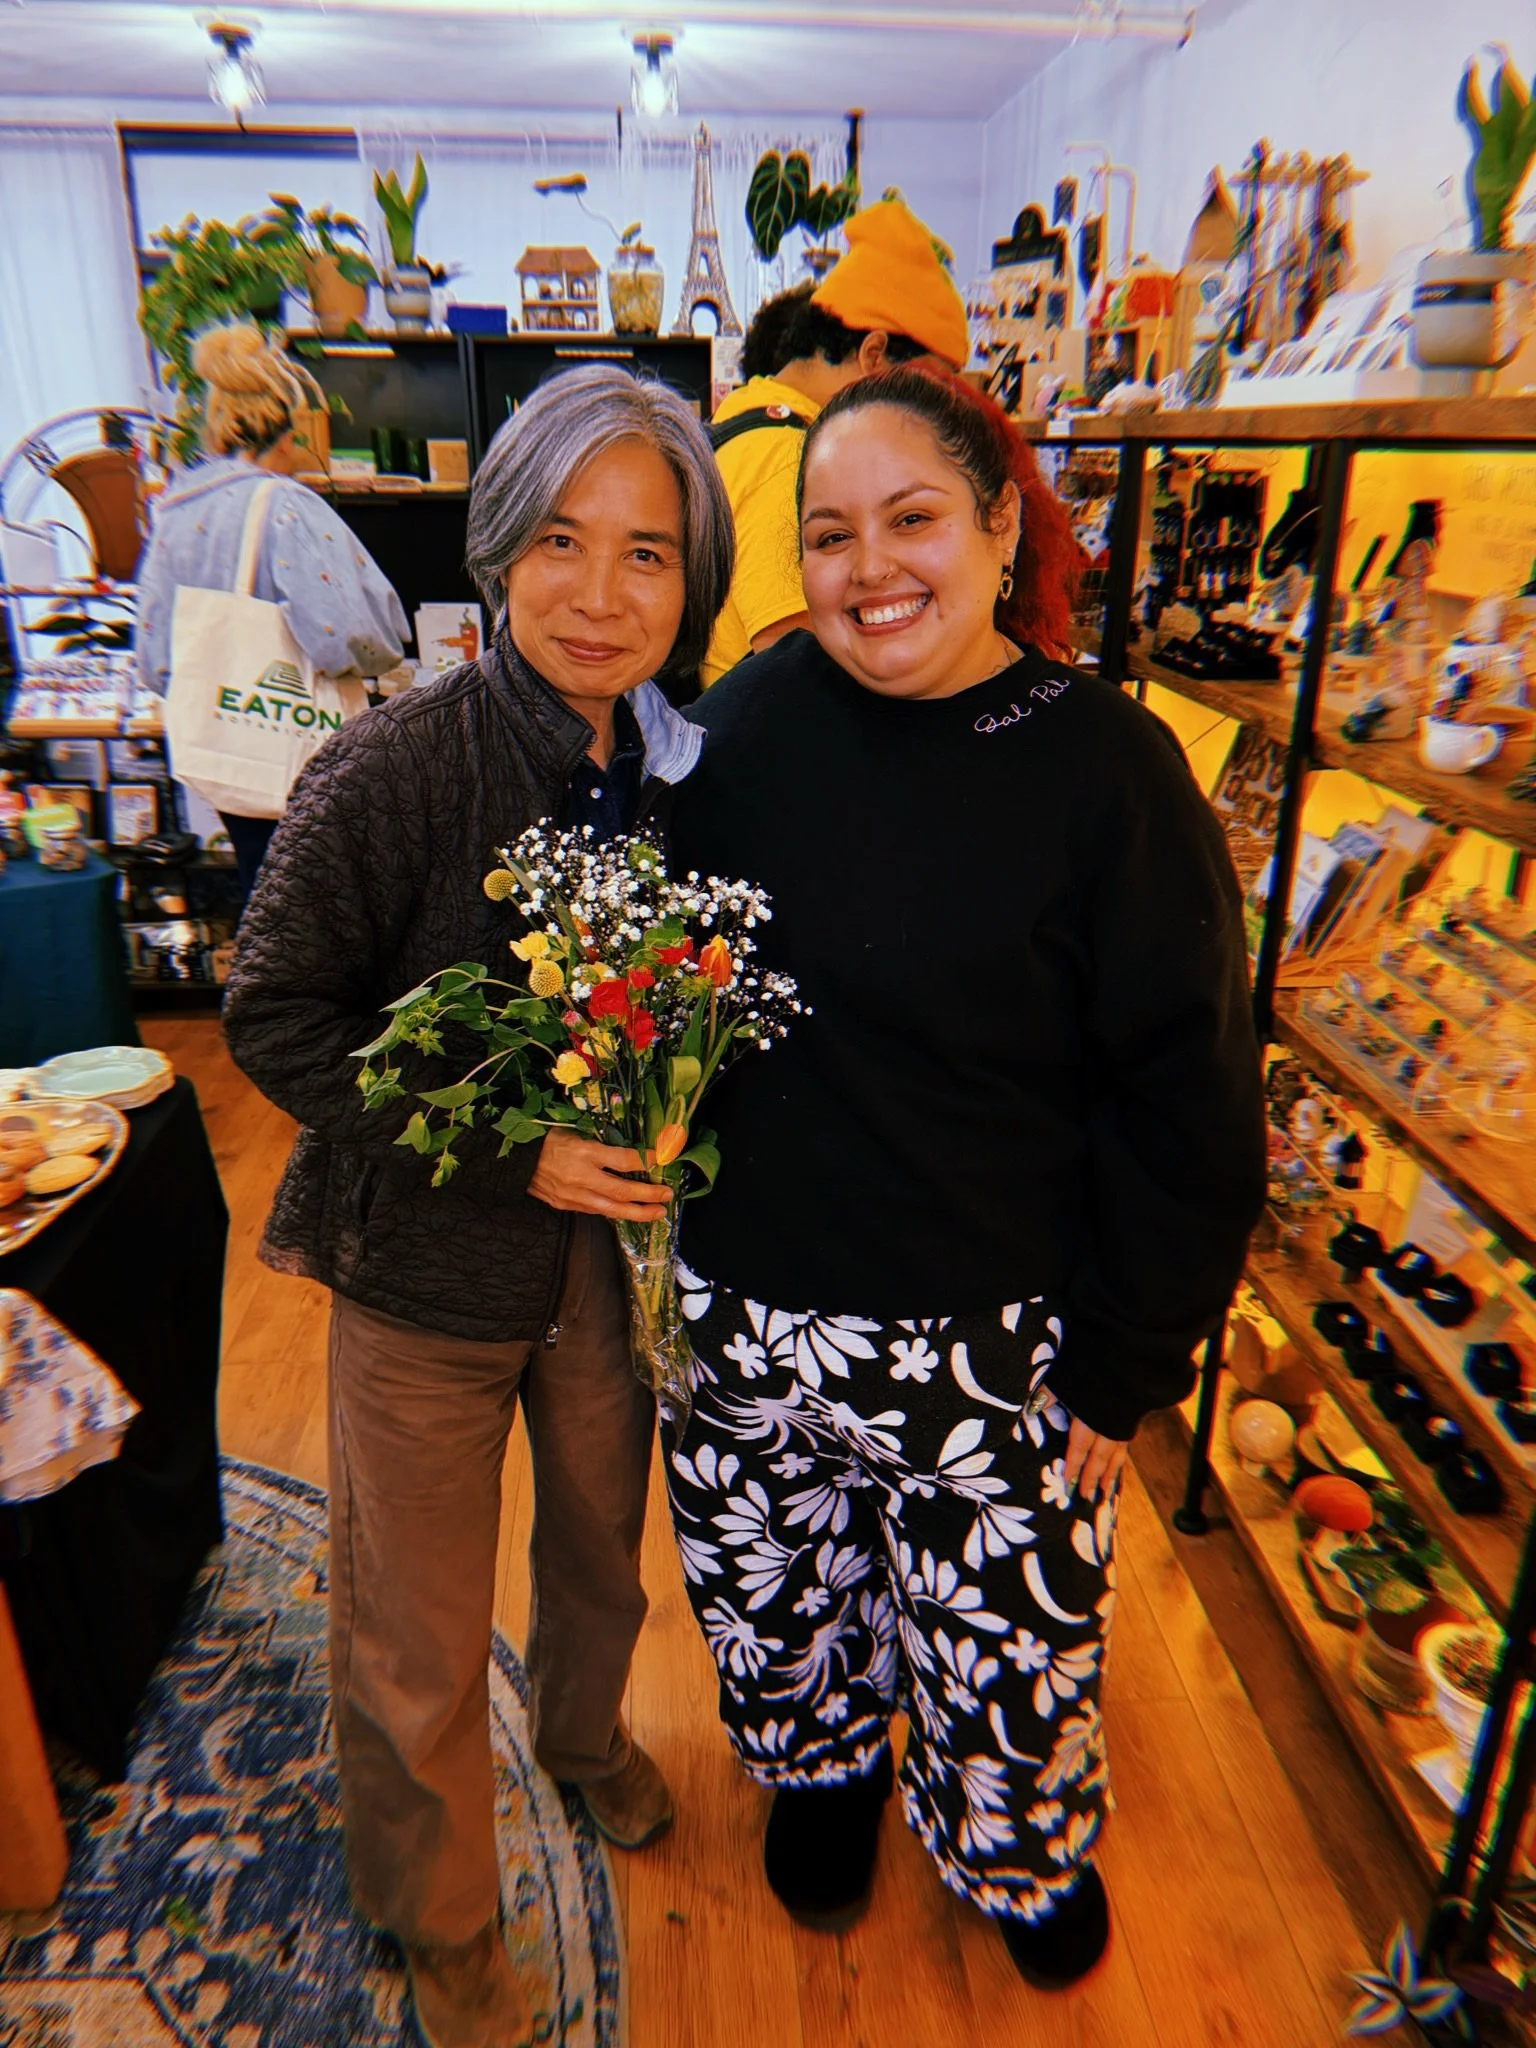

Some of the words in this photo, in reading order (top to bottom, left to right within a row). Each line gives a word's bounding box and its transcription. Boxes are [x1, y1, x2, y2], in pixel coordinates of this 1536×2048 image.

[213, 711, 328, 740] BOTANICA
[216, 685, 342, 731] EATON
[974, 703, 1033, 733] Gal
[1029, 679, 1070, 703] Pal
